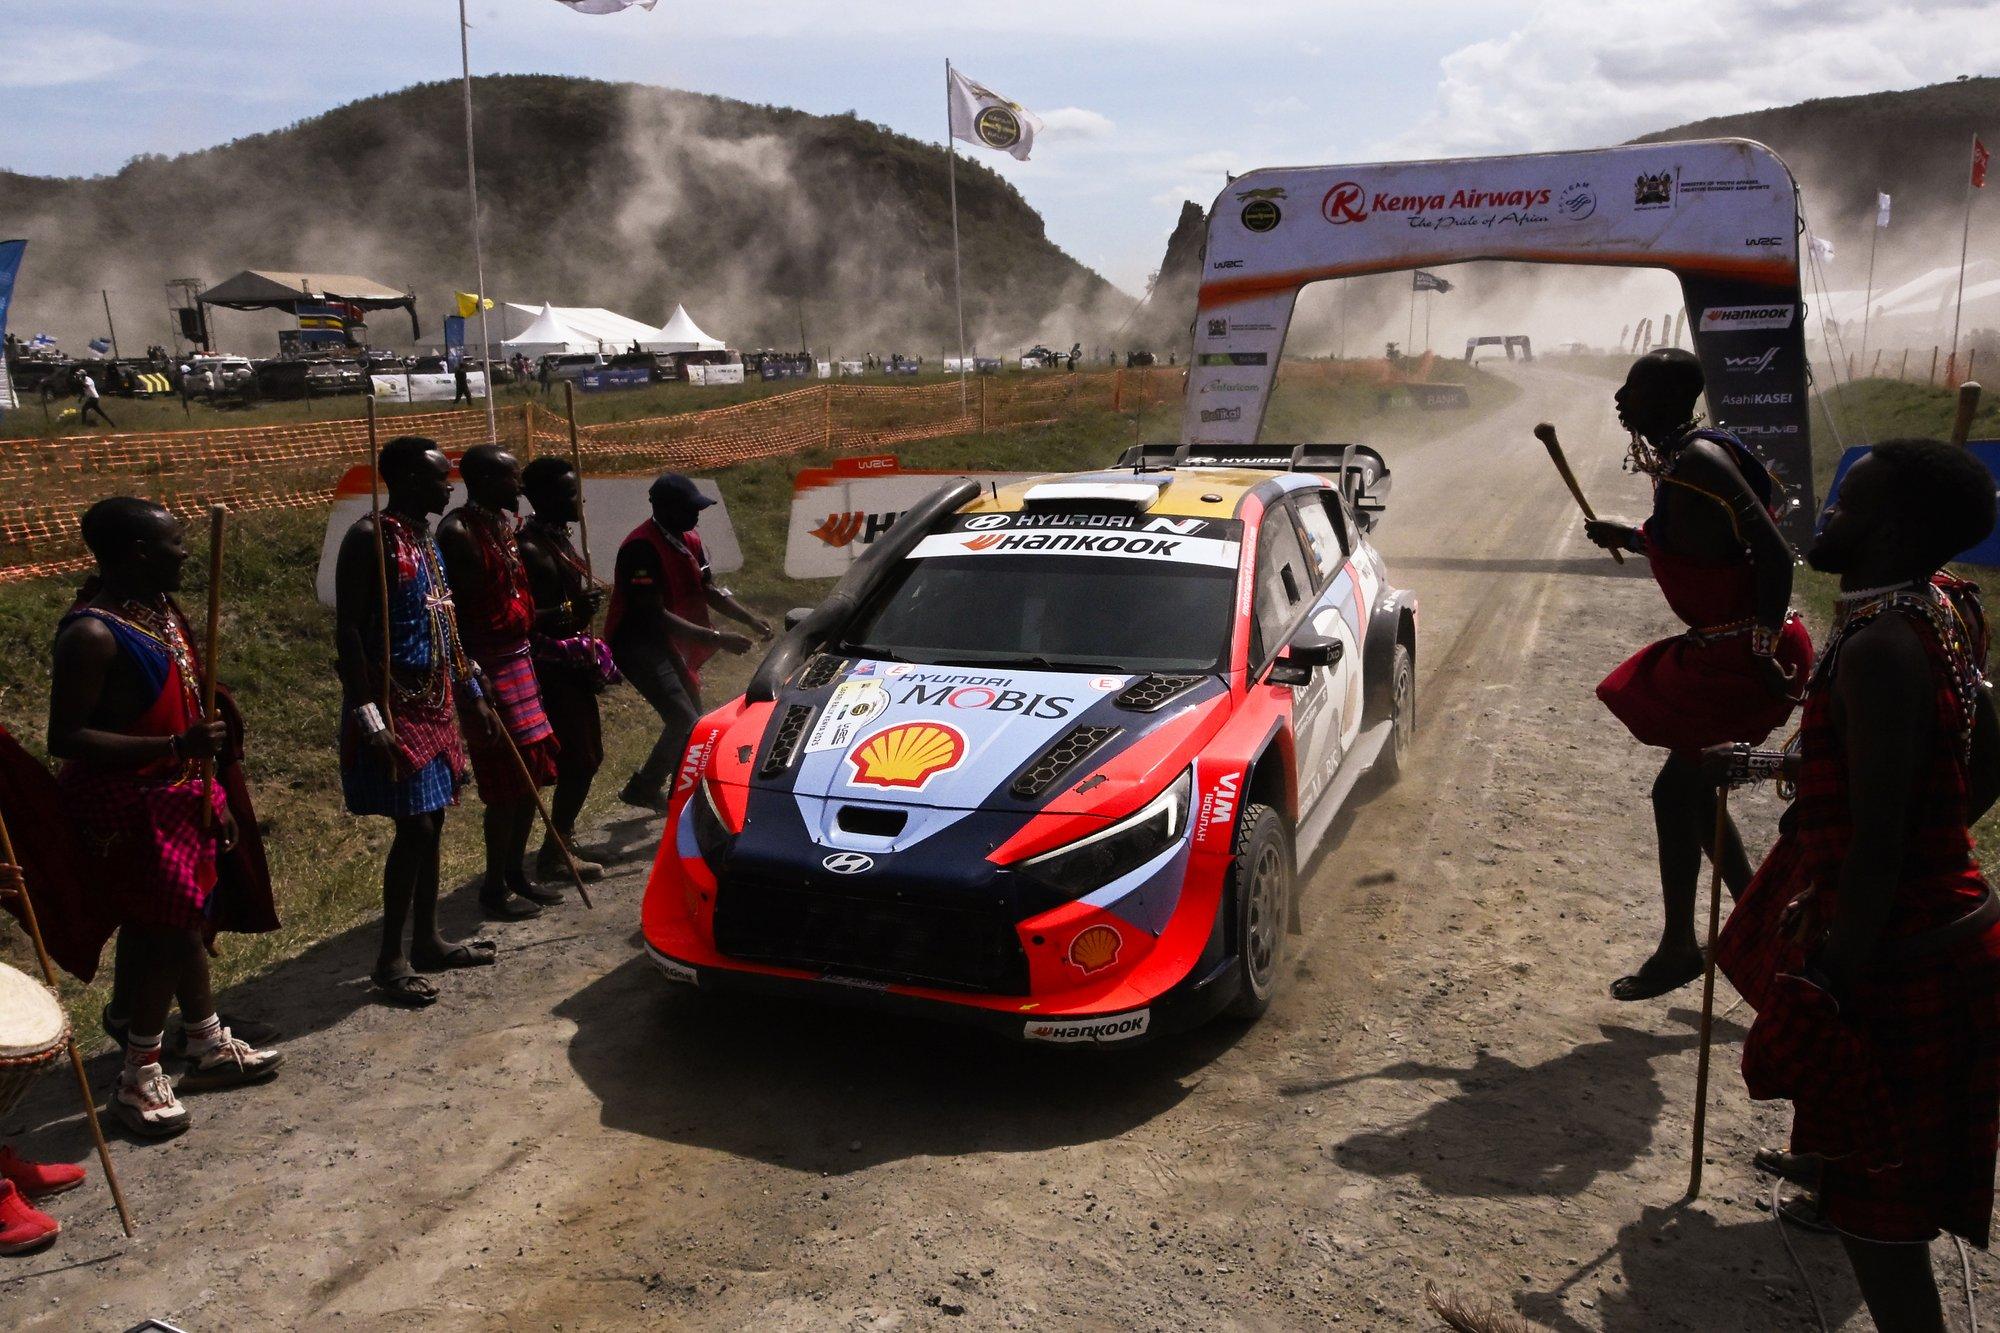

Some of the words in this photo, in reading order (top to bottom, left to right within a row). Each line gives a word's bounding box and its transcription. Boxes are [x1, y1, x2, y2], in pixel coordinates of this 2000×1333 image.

[1371, 192, 1446, 215] Kenya
[1449, 188, 1552, 210] Airways
[1407, 216, 1433, 231] The
[1433, 214, 1478, 231] Pride
[1481, 214, 1497, 228] of
[1498, 212, 1549, 227] Africa
[1745, 237, 1783, 246] WRC
[1213, 260, 1244, 269] WRC
[1721, 393, 1793, 405] AsahiKASEI
[858, 458, 894, 470] WRC
[1015, 514, 1135, 528] HYUNDAI
[898, 673, 1013, 687] HYUNDAI
[1099, 679, 1113, 689] E
[898, 684, 1075, 720] MOBIS
[811, 731, 824, 746] 2025
[699, 729, 720, 770] HYUNDAI
[1196, 793, 1214, 842] HYUNDAI
